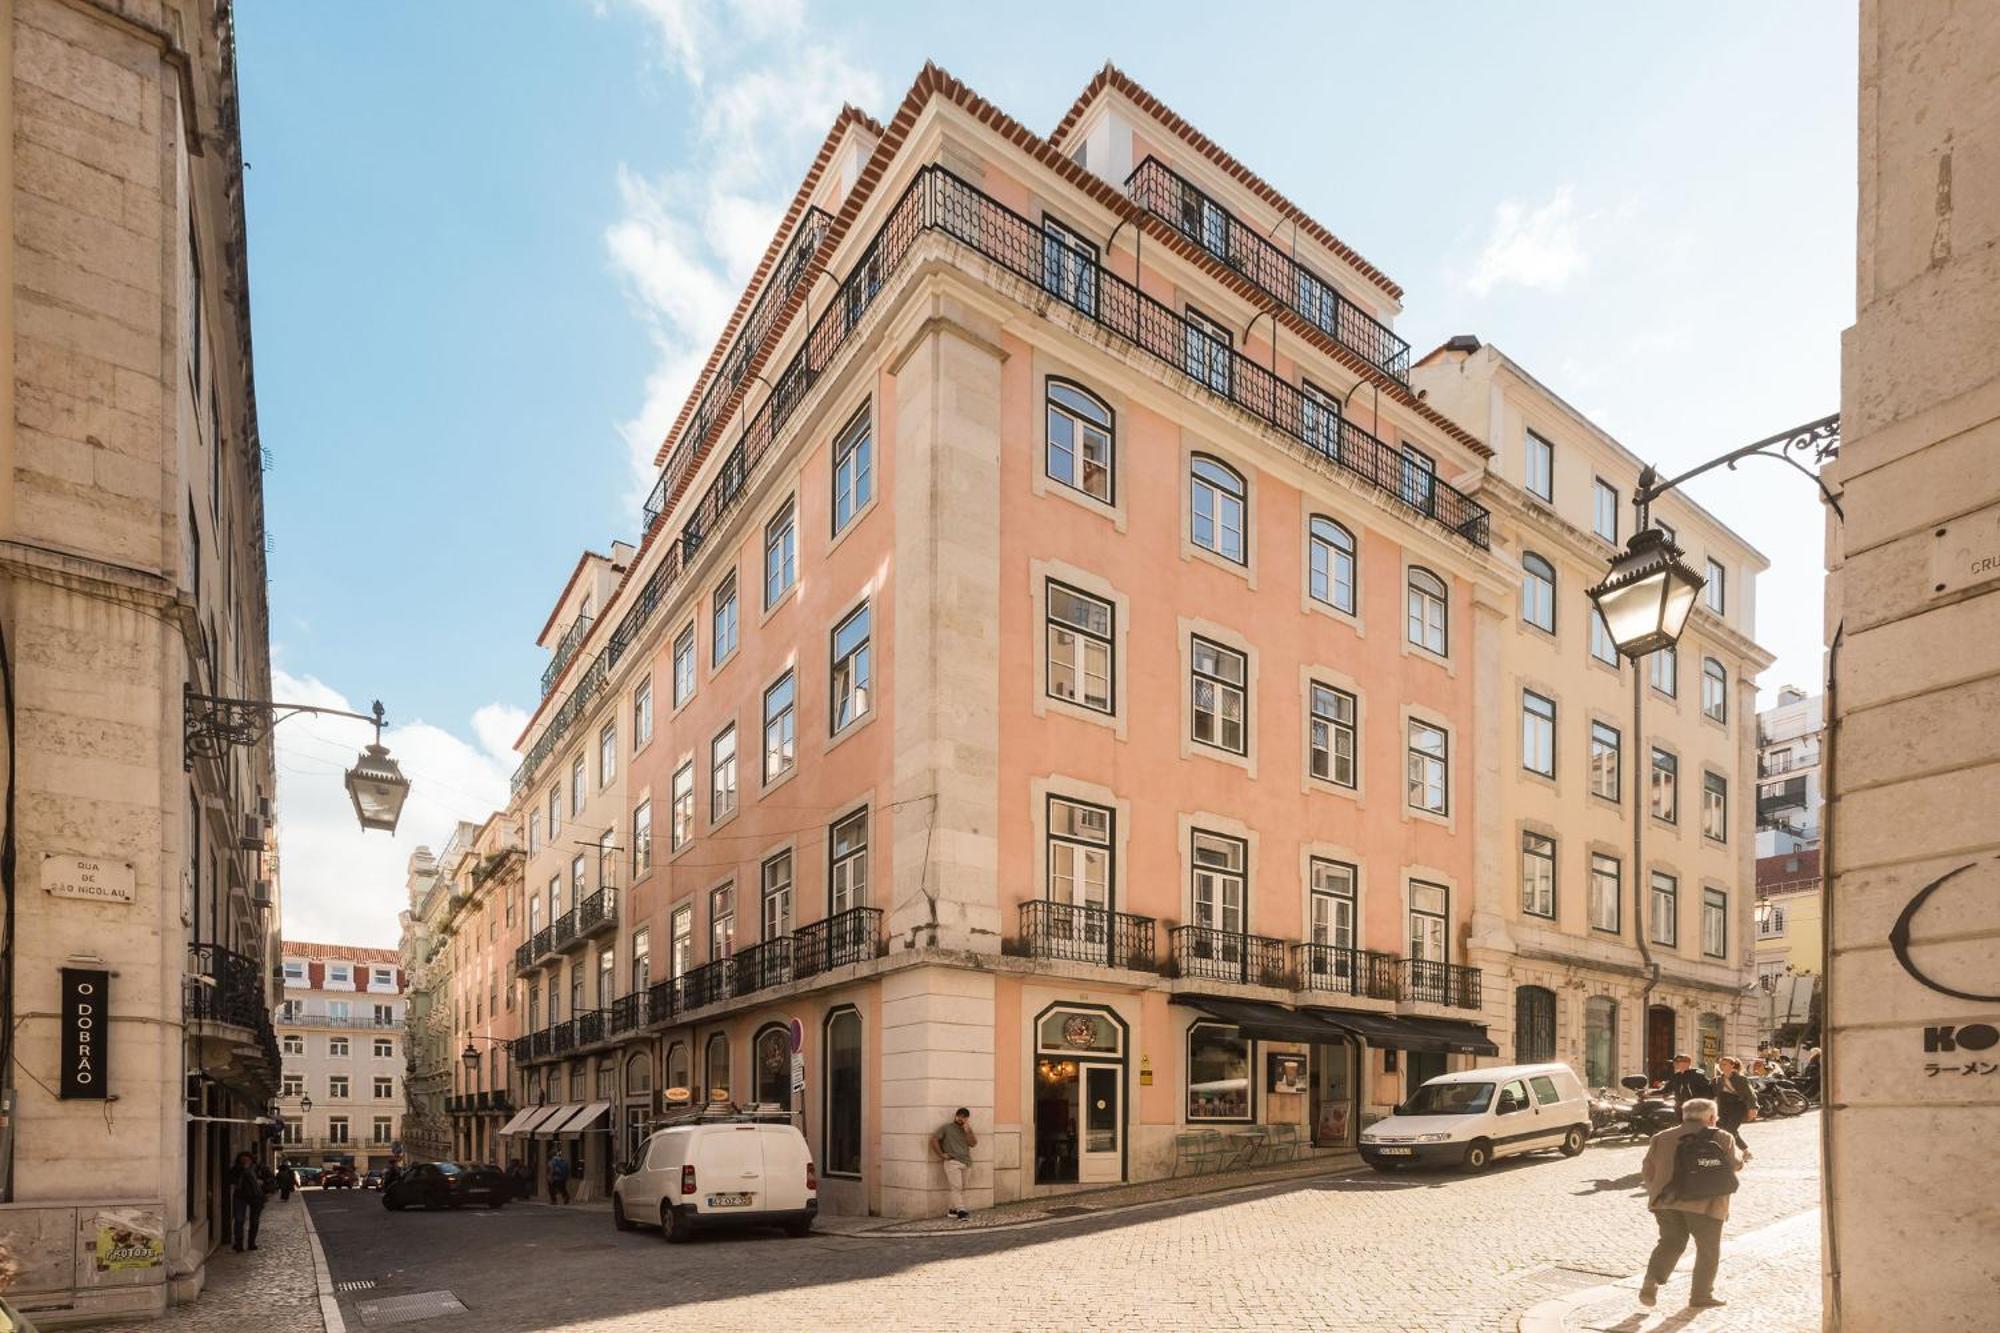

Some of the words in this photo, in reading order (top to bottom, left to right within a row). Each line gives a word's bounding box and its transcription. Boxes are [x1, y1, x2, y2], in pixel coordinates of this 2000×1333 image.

[77, 861, 100, 871] RUA
[81, 874, 96, 883] DE
[78, 885, 125, 898] NICOLAU
[78, 983, 93, 995] O
[77, 1004, 93, 1084] DOBRÃO
[1924, 1061, 1998, 1078] ラーメン
